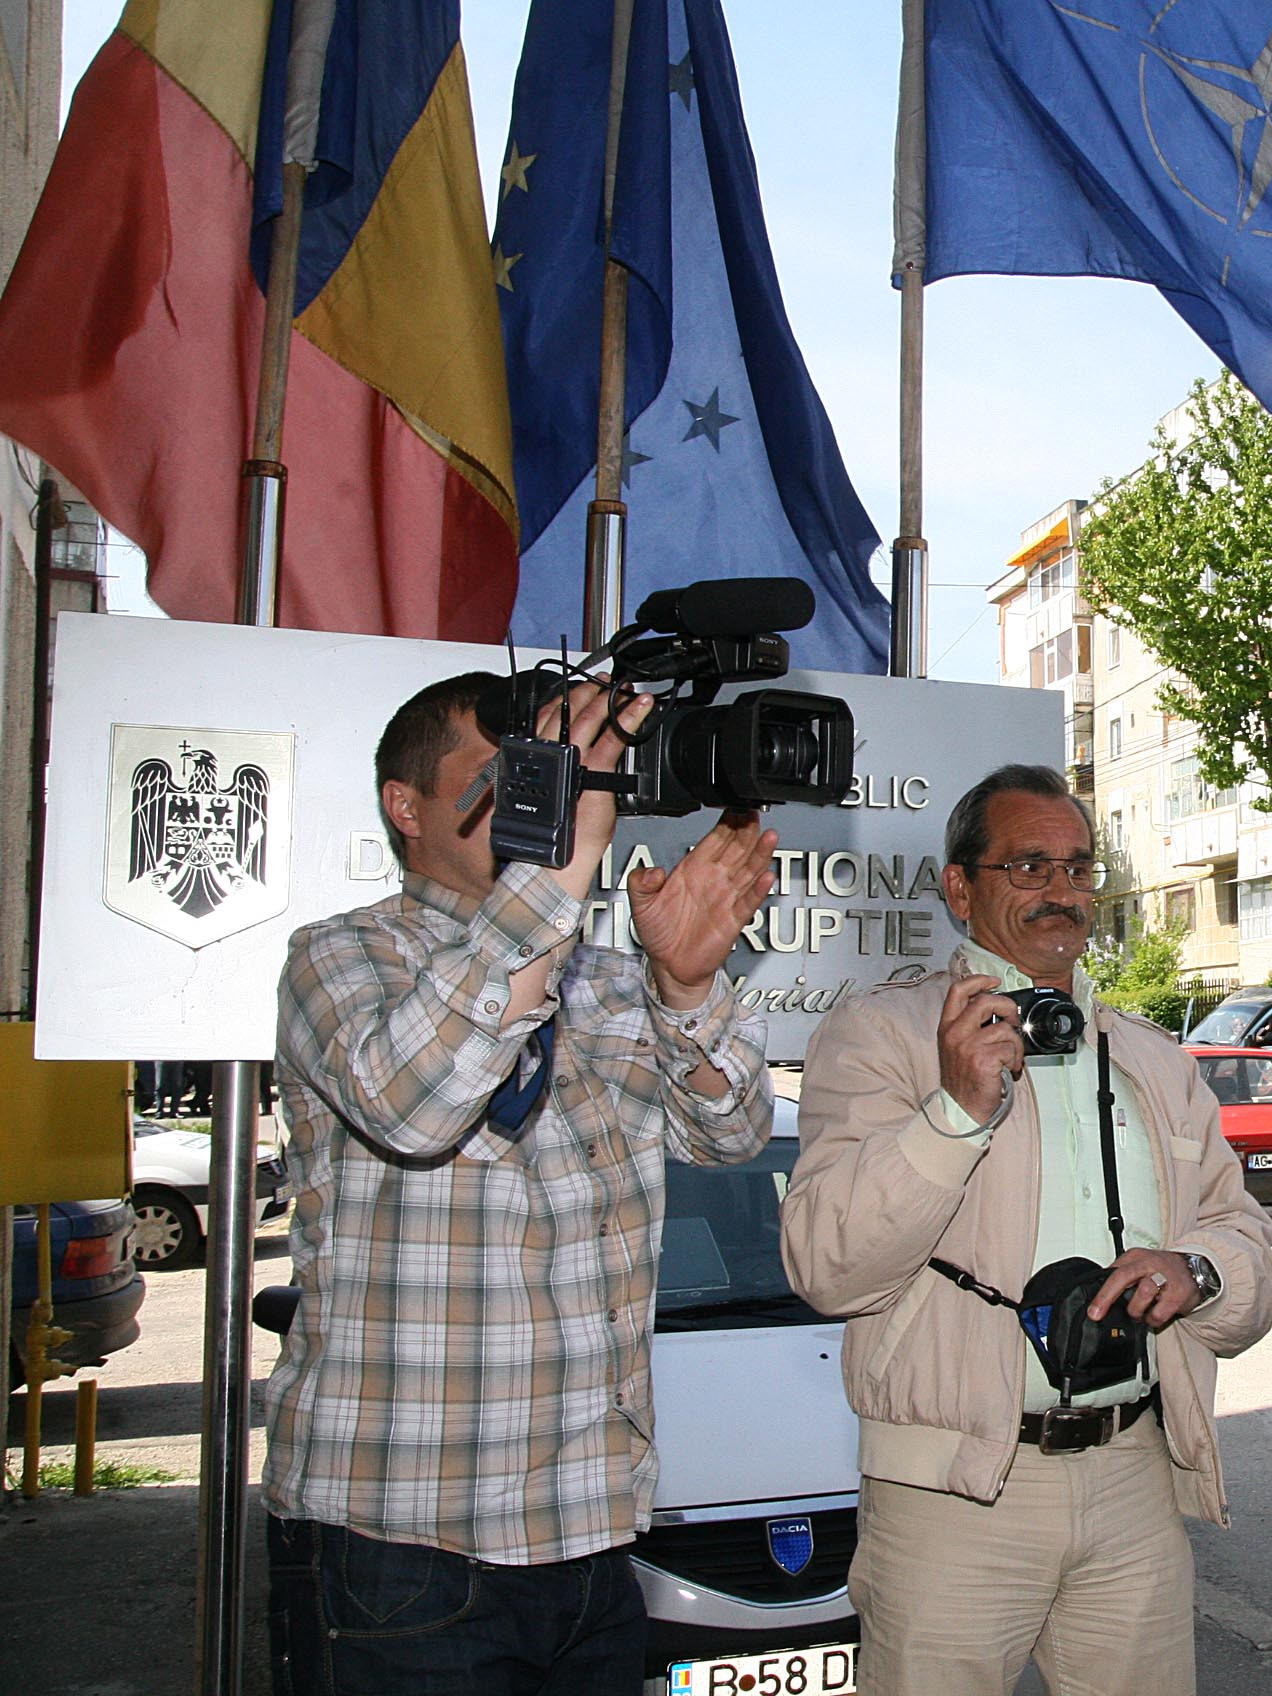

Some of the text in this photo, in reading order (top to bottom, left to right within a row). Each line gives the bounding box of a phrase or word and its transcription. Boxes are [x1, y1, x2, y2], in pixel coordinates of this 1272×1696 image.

[841, 774, 931, 810] BLIC
[515, 803, 538, 813] SONY
[767, 849, 946, 900] TIONA
[1254, 1156, 1268, 1168] AG
[771, 1525, 808, 1534] DACIA
[709, 1663, 738, 1696] B
[759, 1656, 807, 1696] 58
